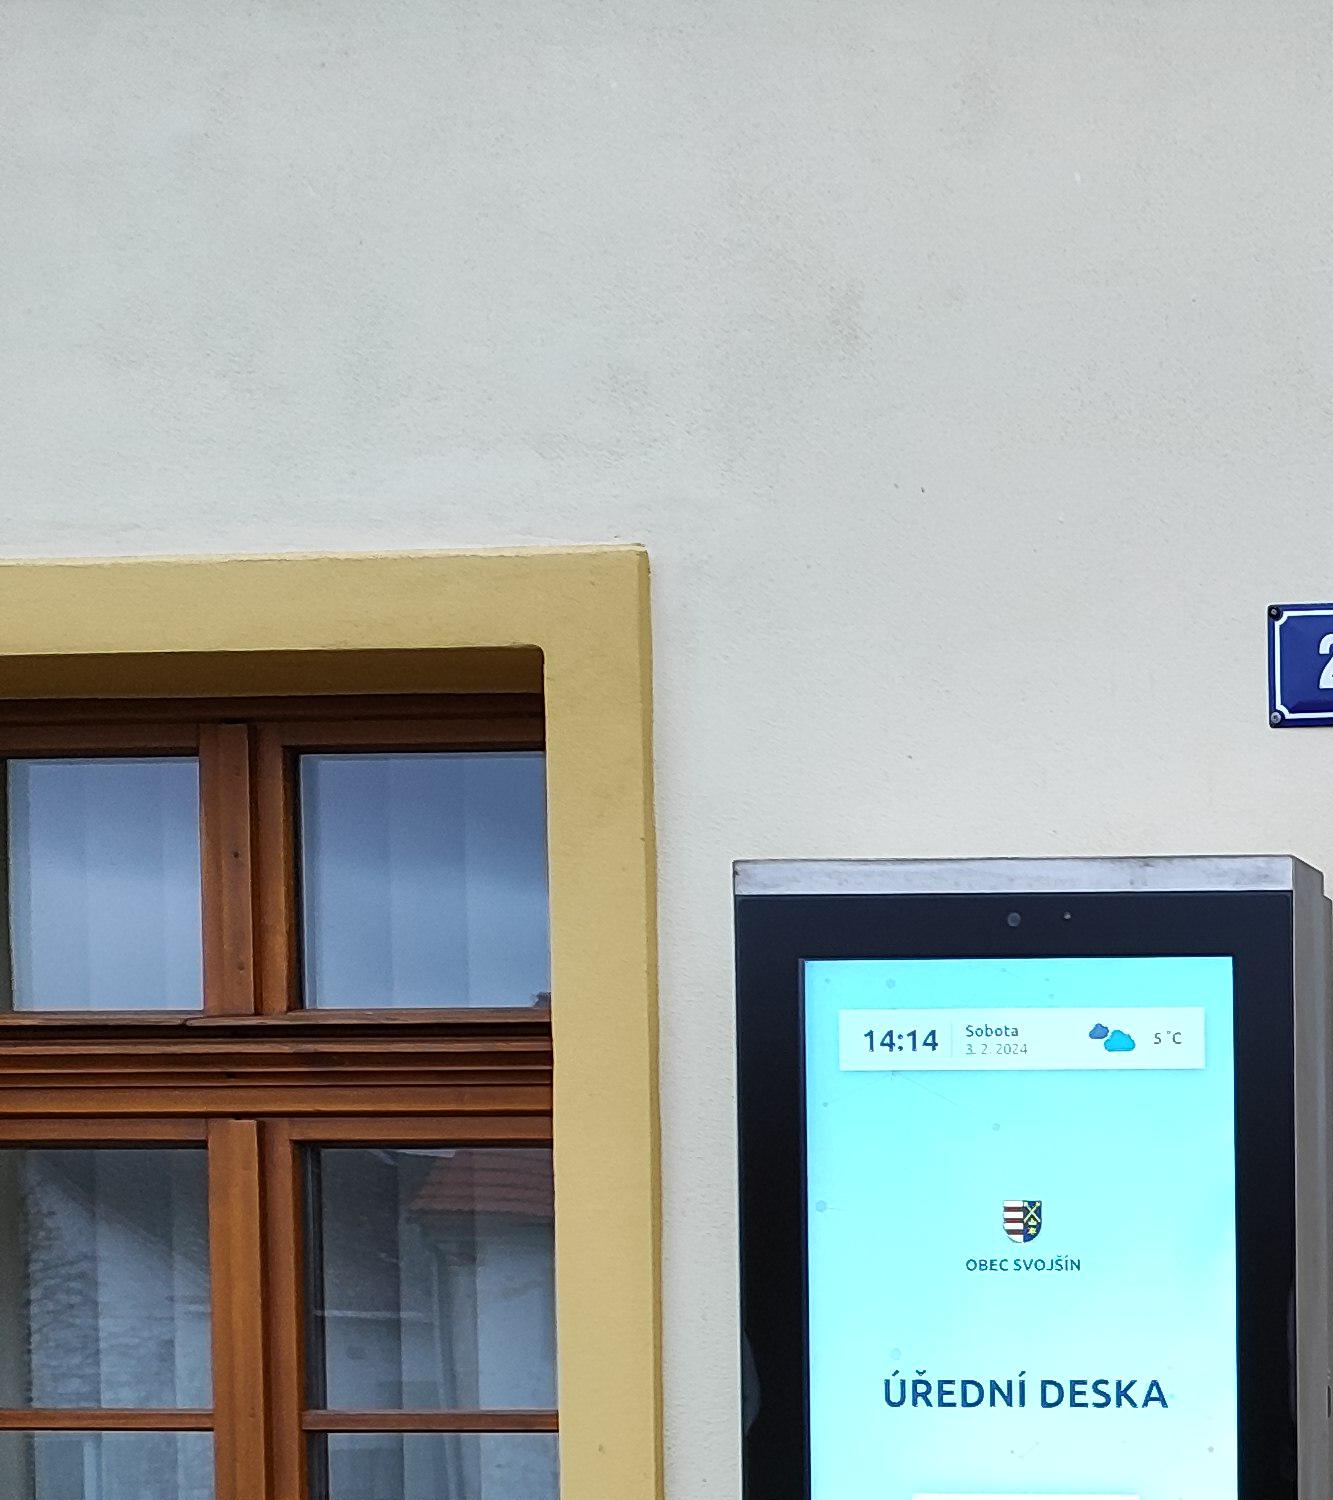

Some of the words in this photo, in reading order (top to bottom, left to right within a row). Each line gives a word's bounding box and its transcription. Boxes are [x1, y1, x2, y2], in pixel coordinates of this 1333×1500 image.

[965, 1024, 1019, 1037] Sobota
[1153, 1032, 1161, 1044] 5
[863, 1029, 939, 1052] 14:14
[995, 1043, 1028, 1055] 2024
[965, 1258, 1009, 1272] OBEC
[1013, 1255, 1081, 1272] SVOJŠÍN
[883, 1369, 1028, 1409] ÚŘEDNÍ
[1040, 1377, 1170, 1409] DESKA
